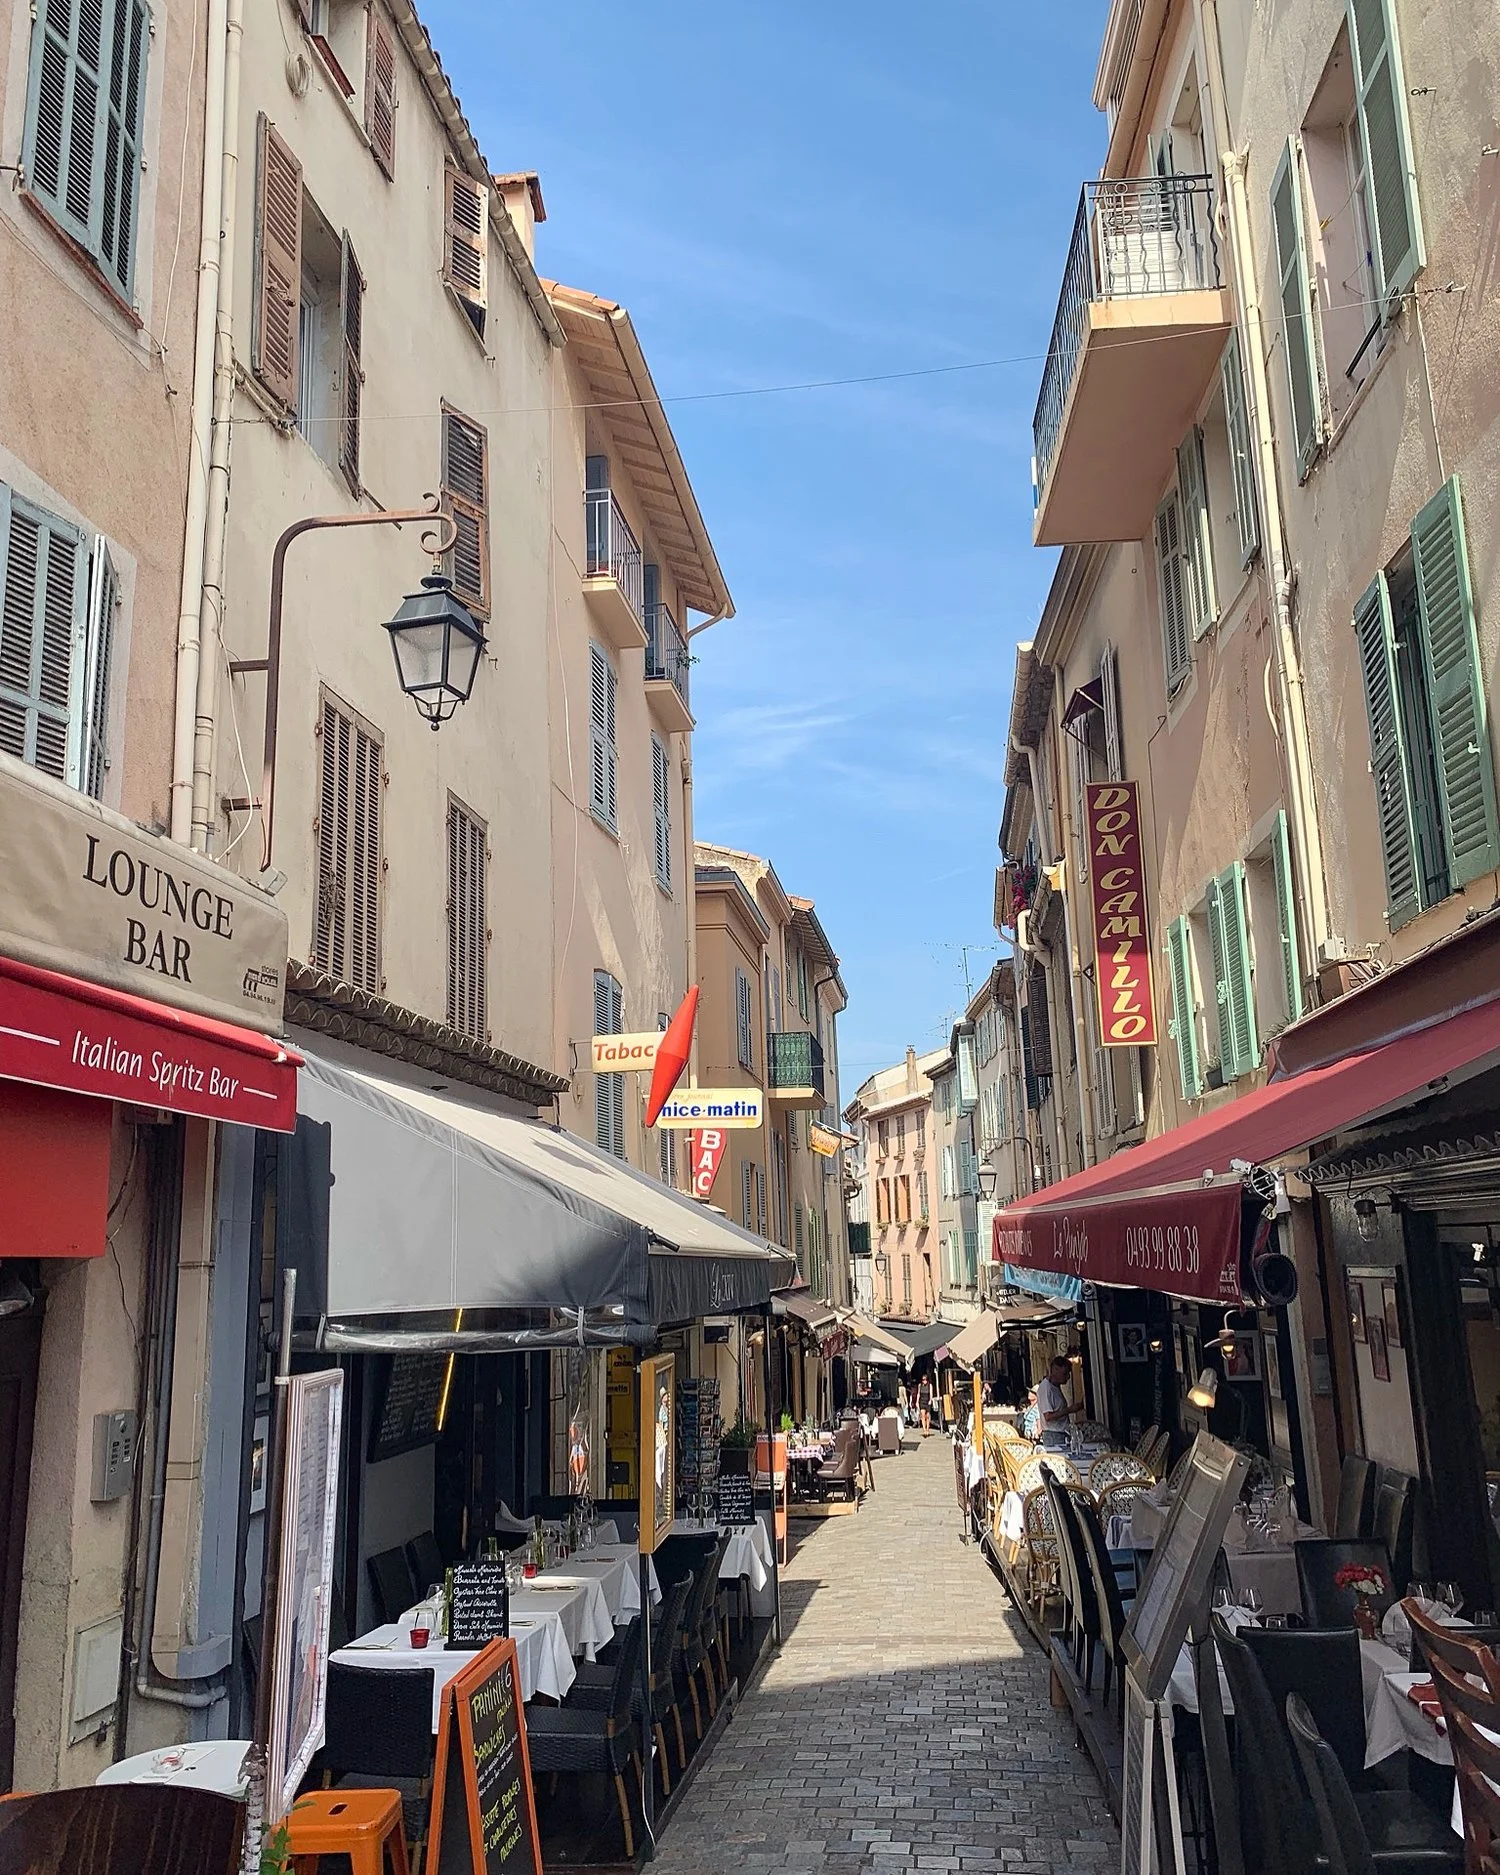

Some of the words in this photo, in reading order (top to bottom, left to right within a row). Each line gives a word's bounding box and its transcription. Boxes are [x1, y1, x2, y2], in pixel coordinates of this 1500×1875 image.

[1093, 788, 1134, 856] DON
[83, 833, 234, 940] LOUNGE
[123, 917, 192, 984] BAR
[1100, 867, 1147, 1039] CAMILLO
[72, 1030, 143, 1078] Italian
[149, 1051, 205, 1092] Spritz
[208, 1067, 239, 1100] Bar
[594, 1042, 654, 1061] Tabac
[697, 1129, 722, 1192] BAC
[1126, 1226, 1150, 1269] 0493
[1167, 1225, 1182, 1273] 88
[1183, 1225, 1199, 1274] 38
